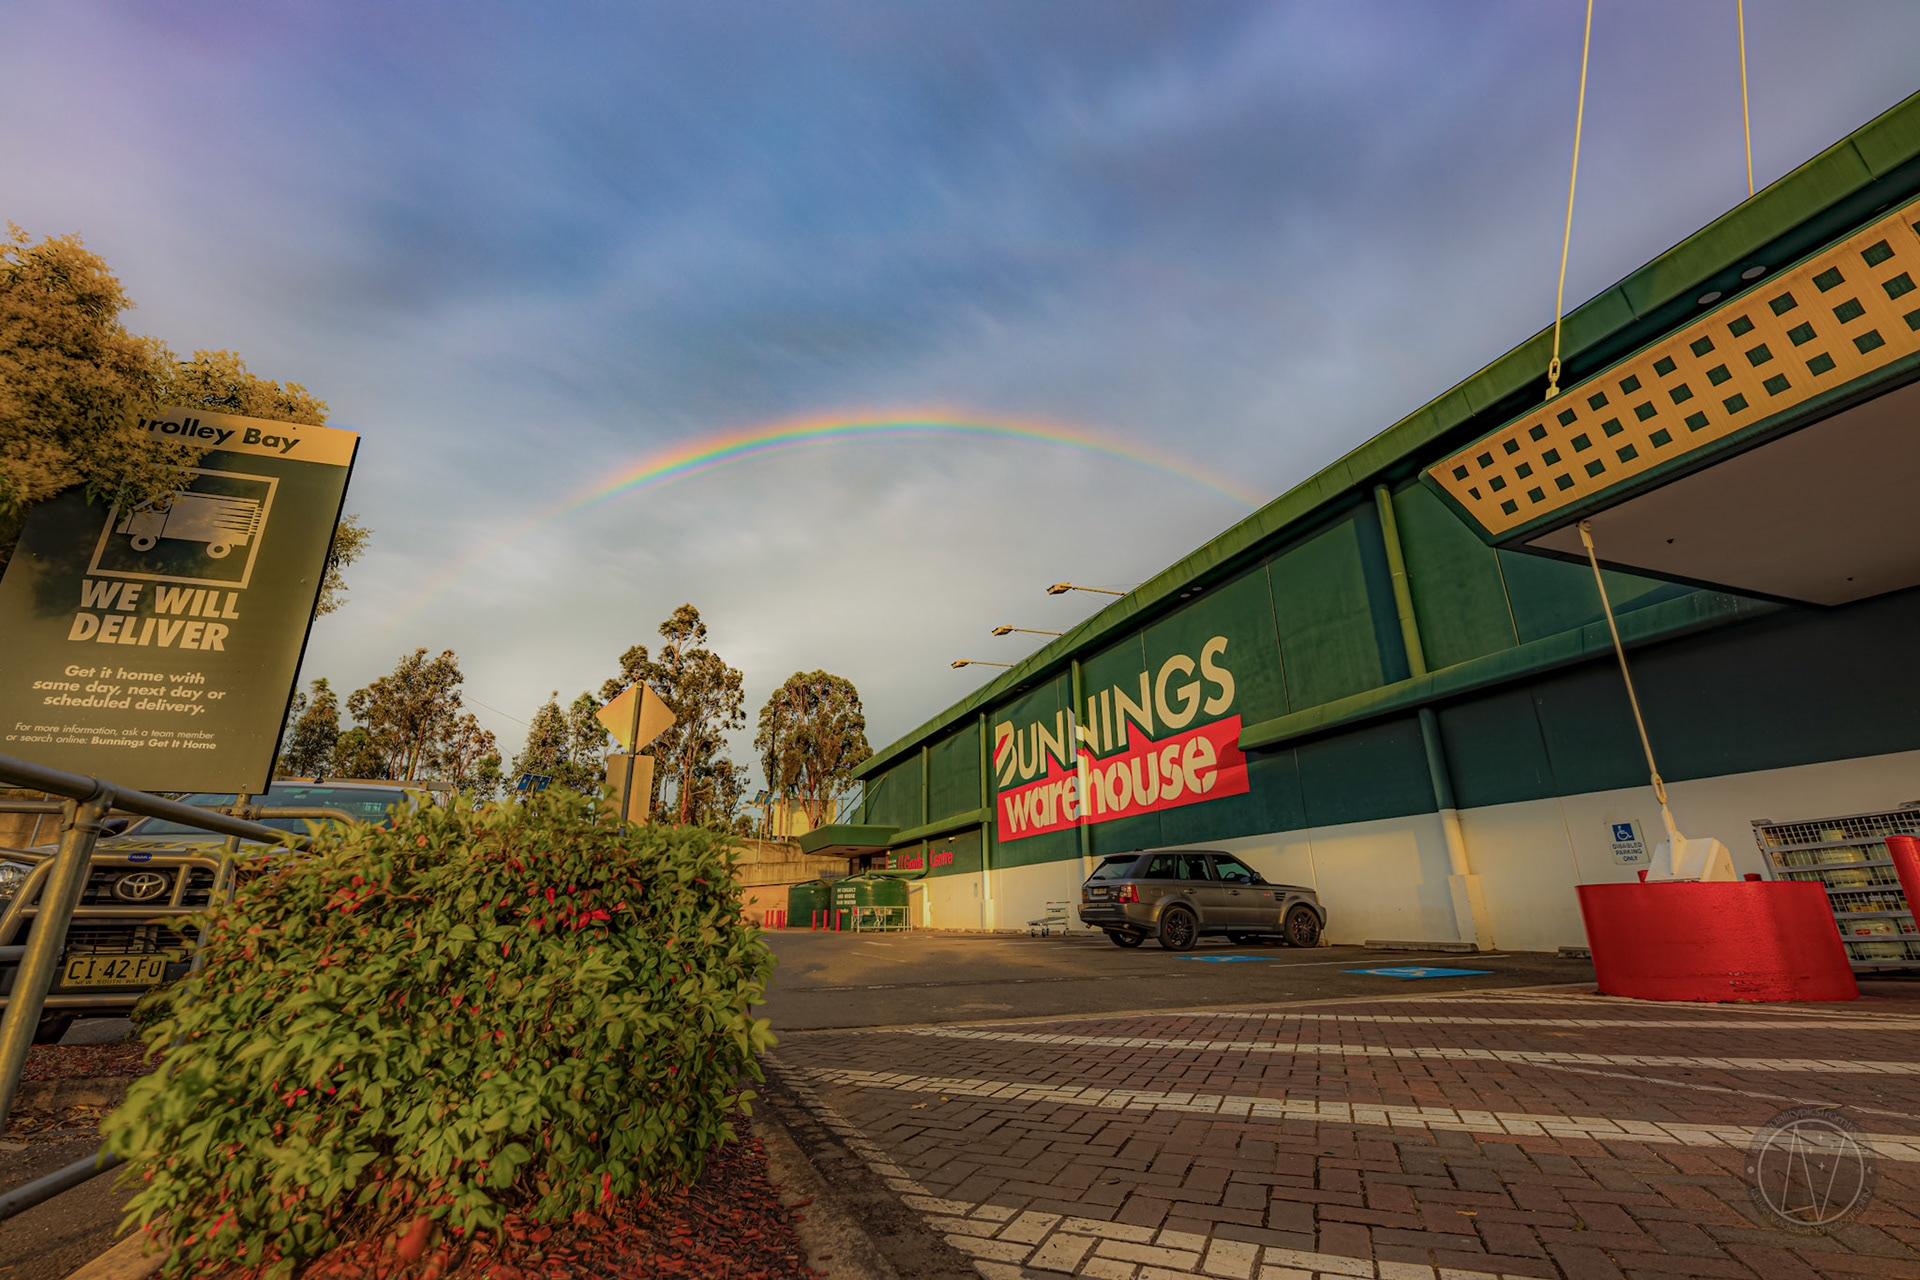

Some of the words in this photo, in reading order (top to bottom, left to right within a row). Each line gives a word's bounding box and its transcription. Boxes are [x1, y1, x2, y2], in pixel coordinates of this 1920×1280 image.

[243, 428, 300, 454] Bay
[80, 579, 143, 611] WE
[155, 585, 240, 620] WILL
[67, 612, 230, 652] DELIVER
[64, 665, 96, 678] Get
[100, 666, 113, 679] it
[116, 667, 164, 682] home
[169, 671, 206, 684] with
[32, 679, 80, 692] same
[85, 680, 122, 697] day,
[127, 684, 167, 697] next
[170, 686, 203, 702] day
[207, 690, 226, 700] or
[43, 693, 131, 709] scheduled
[134, 697, 206, 716] delivery.
[993, 635, 1235, 788] BUNNINGS
[5, 734, 18, 742] or
[20, 733, 53, 743] search
[56, 735, 88, 745] online:
[91, 736, 145, 749] Bunnings
[148, 738, 169, 748] Get
[171, 739, 181, 748] It
[182, 740, 217, 750] Home
[14, 722, 32, 732] For
[34, 724, 60, 733] more
[62, 724, 118, 737] information,
[122, 727, 138, 737] ask
[141, 729, 148, 737] a
[150, 729, 175, 738] team
[177, 730, 216, 740] member
[1004, 736, 1218, 834] warehouse
[904, 850, 923, 870] Garde
[929, 849, 953, 868] Centre
[1615, 848, 1643, 856] PARKING
